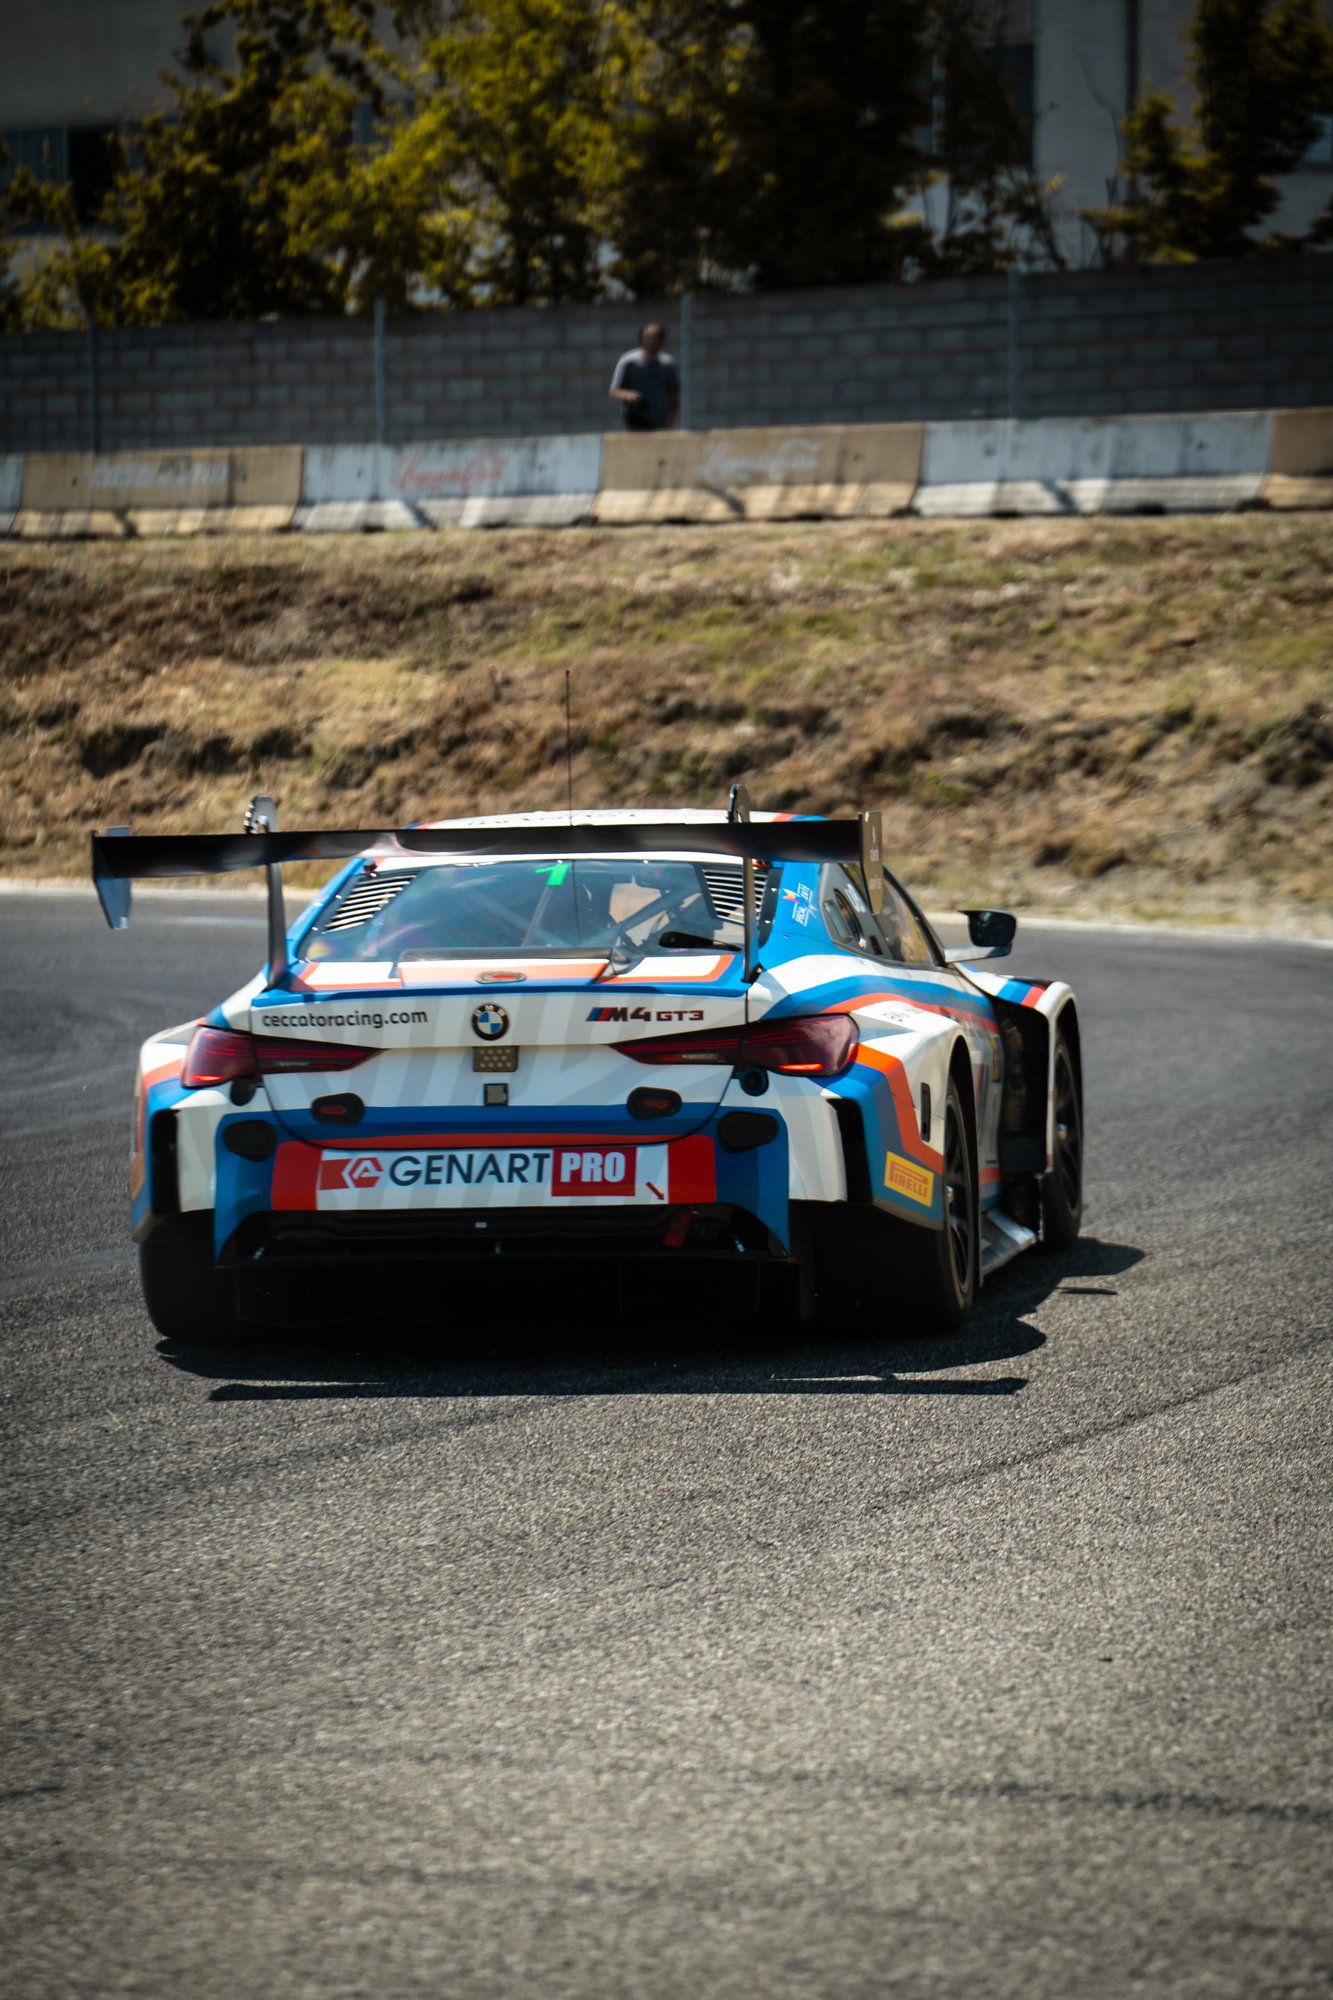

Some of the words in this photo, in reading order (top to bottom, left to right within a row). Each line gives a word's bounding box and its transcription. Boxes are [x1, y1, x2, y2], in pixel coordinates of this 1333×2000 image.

[534, 863, 570, 886] 1
[262, 1010, 428, 1029] ceccatoracing.com
[656, 1009, 704, 1022] GT3
[389, 1152, 551, 1187] GENART
[560, 1151, 626, 1183] PRO
[889, 1160, 929, 1199] PIRELLI
